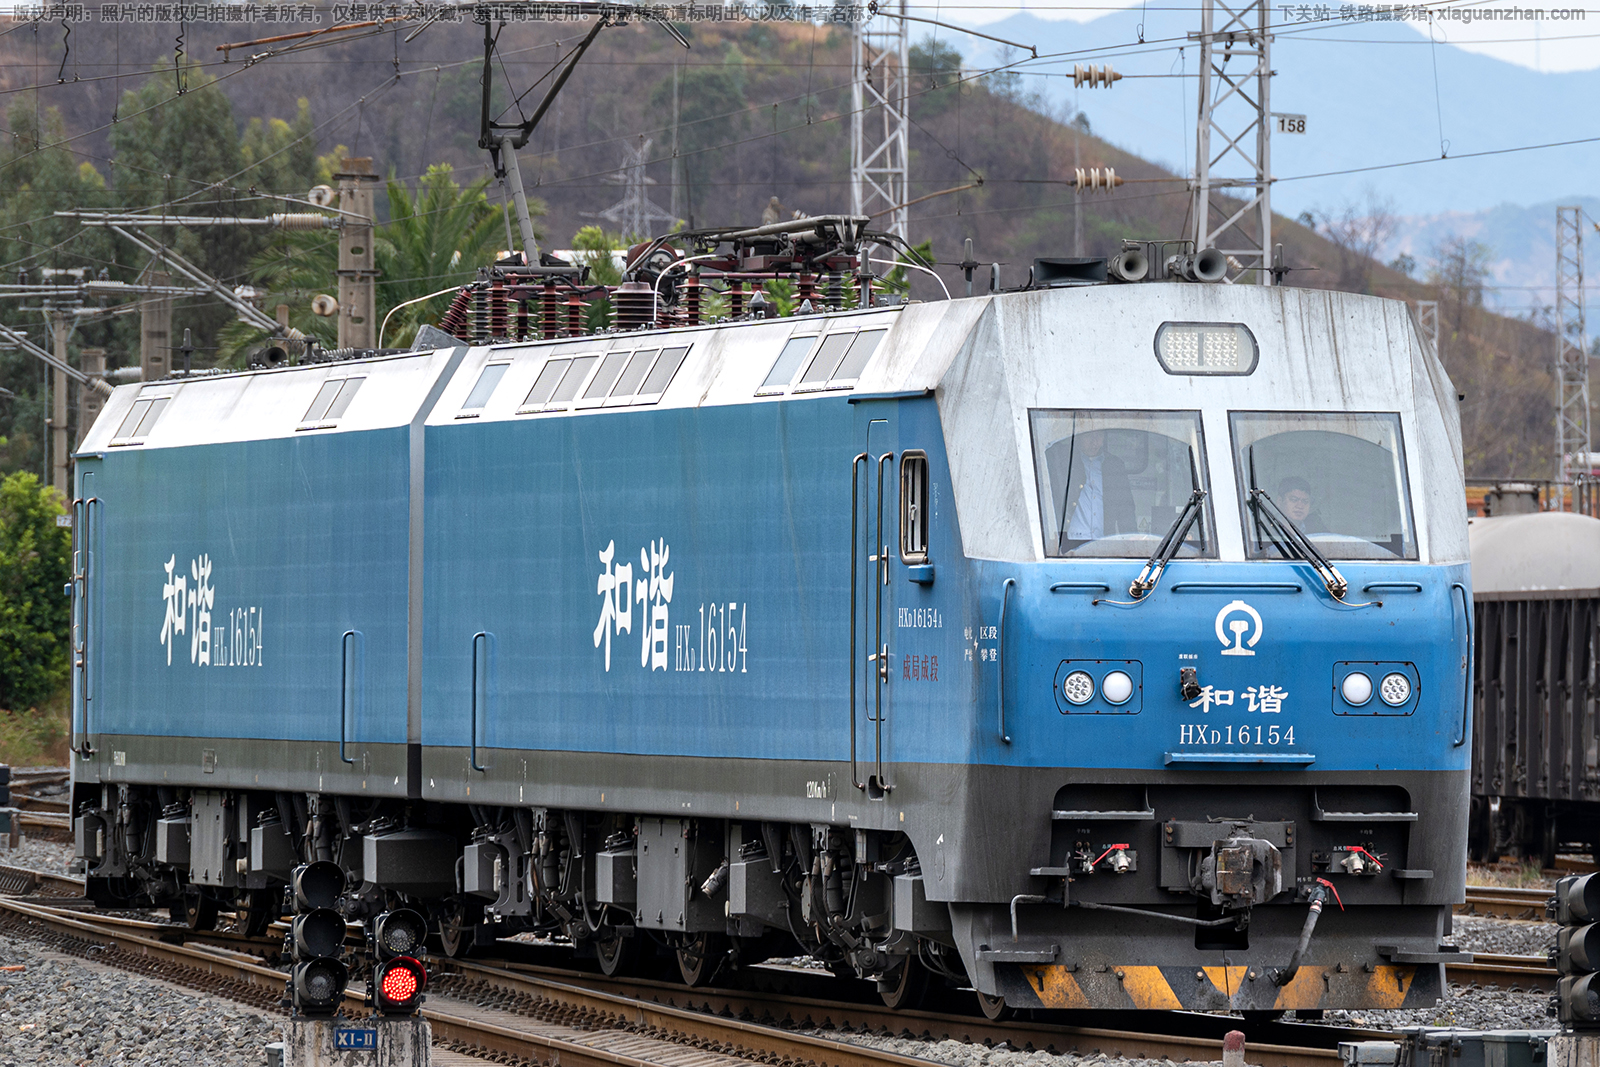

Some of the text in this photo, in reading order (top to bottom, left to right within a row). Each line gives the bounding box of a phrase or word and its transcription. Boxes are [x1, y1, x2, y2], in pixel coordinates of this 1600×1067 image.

[1279, 118, 1306, 133] 158
[160, 553, 215, 667] 和谐
[593, 536, 748, 674] 和谐 HXD16154
[902, 654, 939, 682] 成局成段
[1188, 684, 1289, 714] 和谐
[1179, 724, 1296, 746] HXD16154
